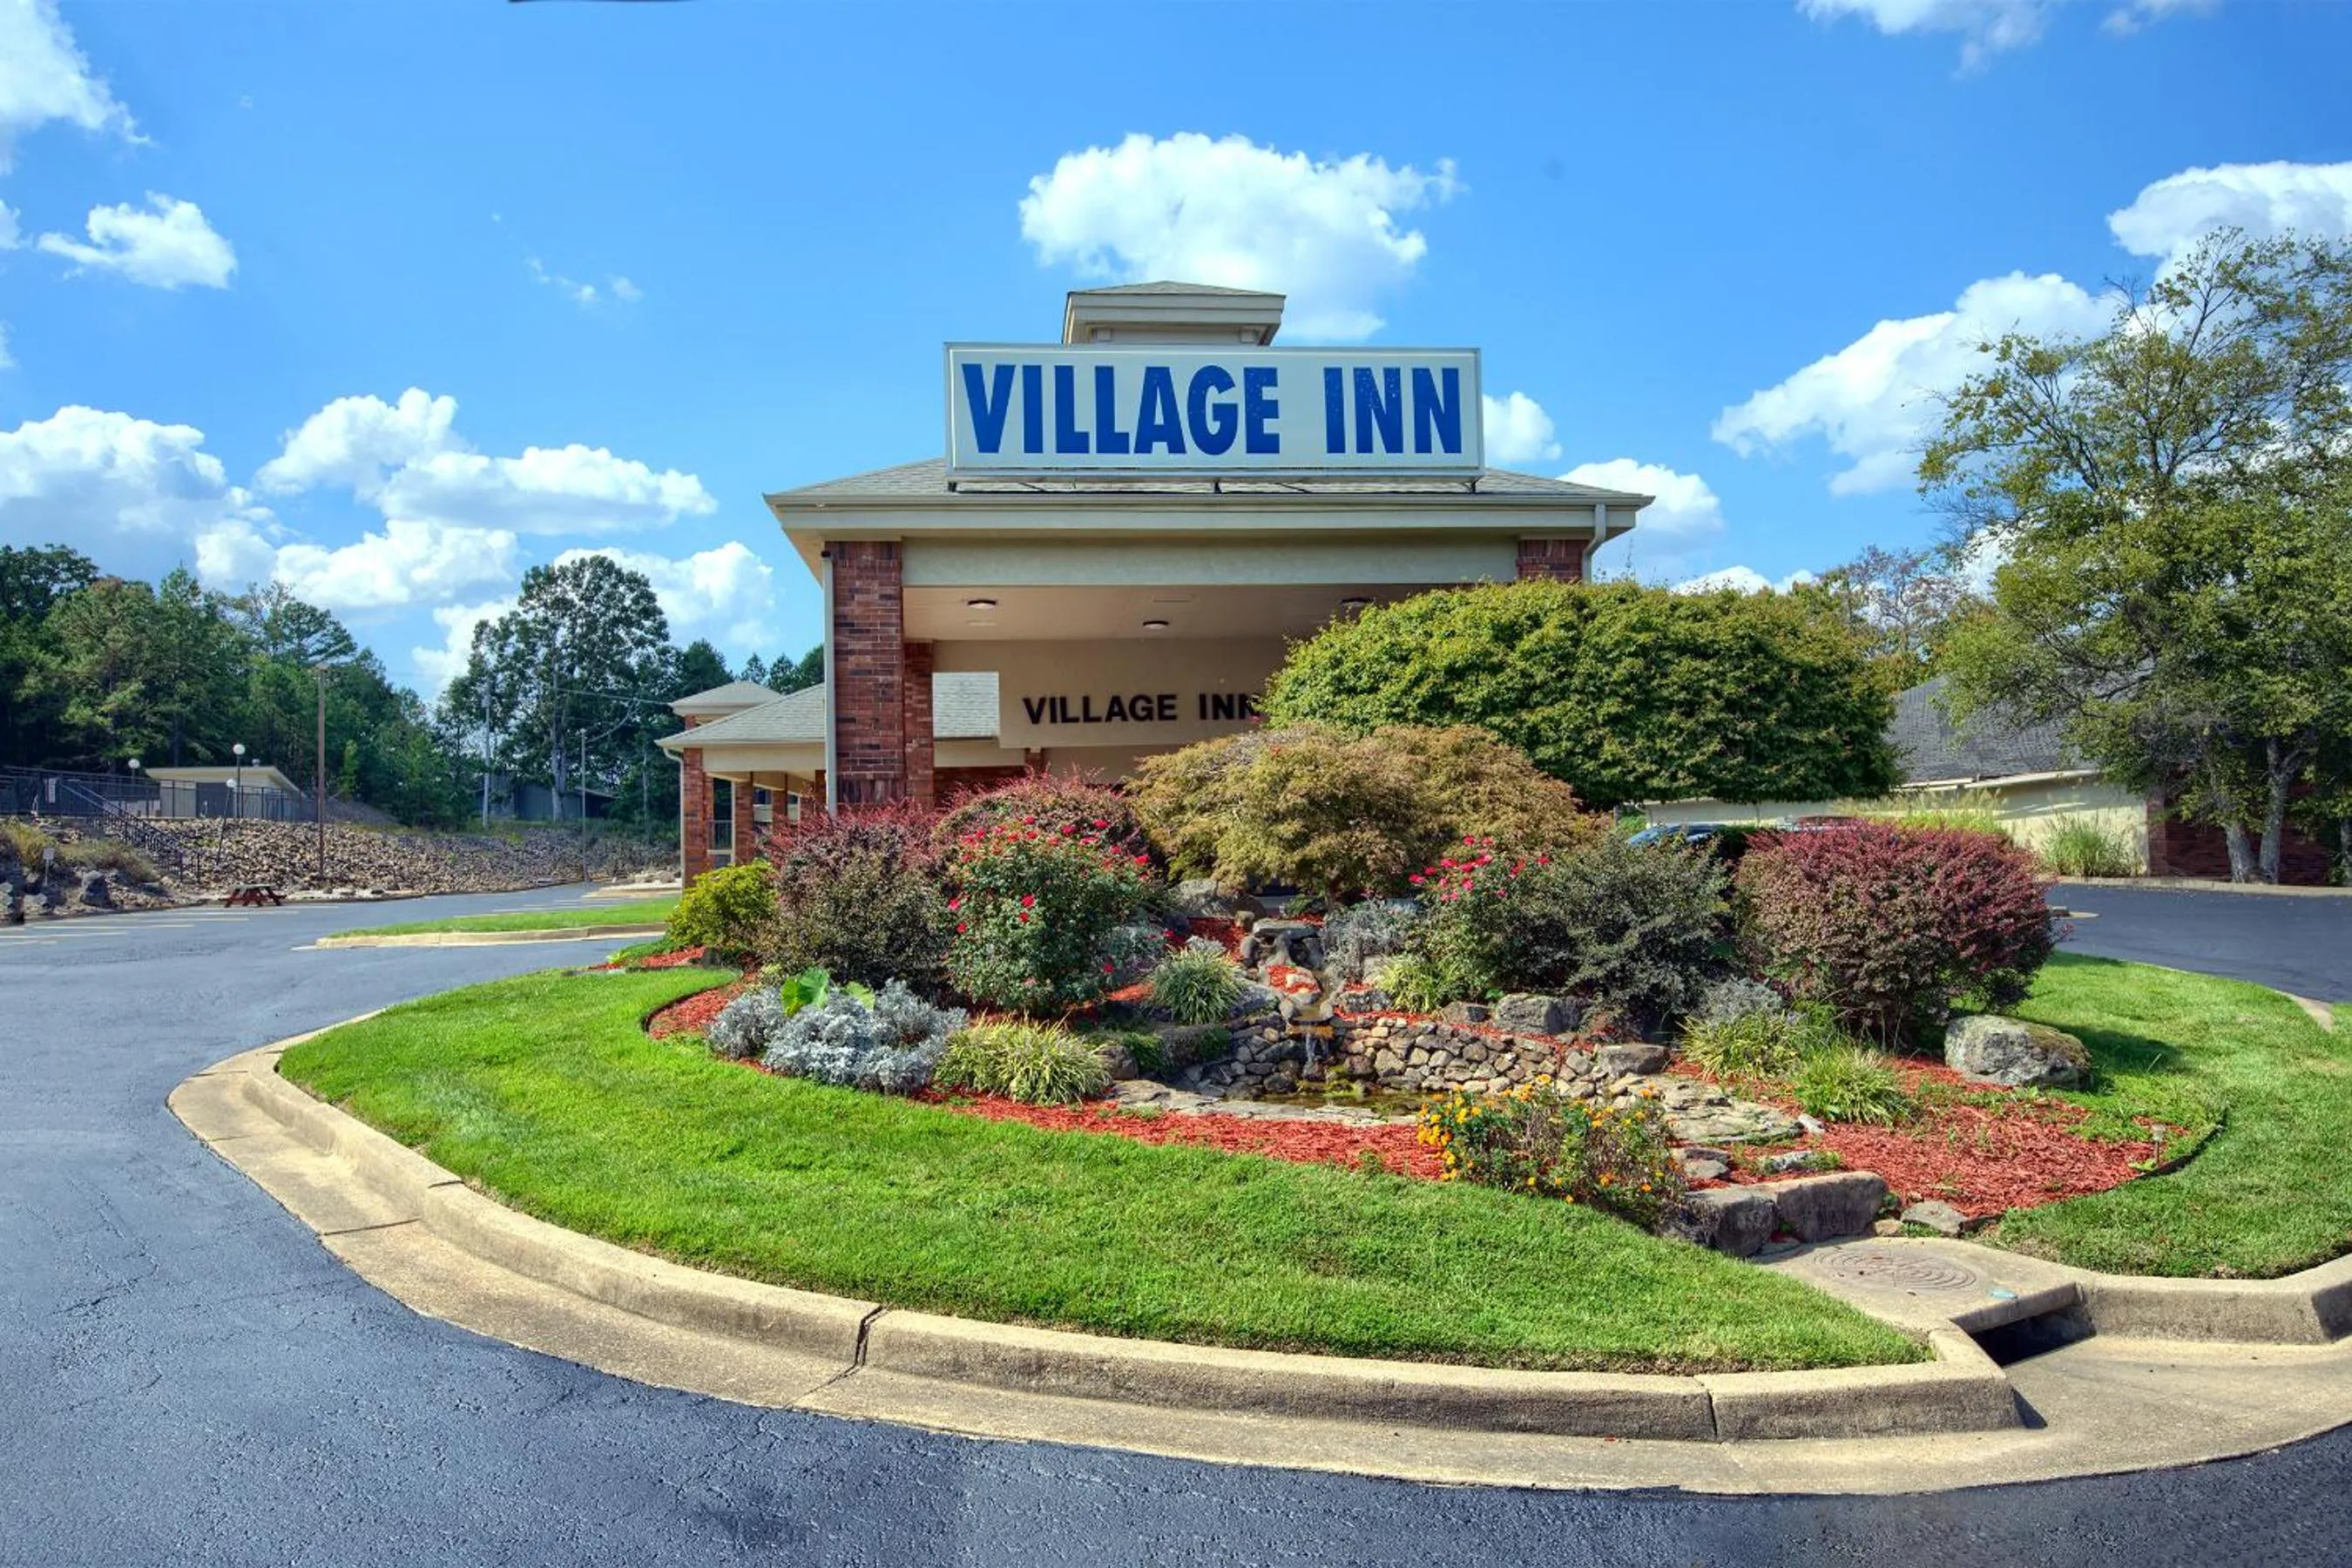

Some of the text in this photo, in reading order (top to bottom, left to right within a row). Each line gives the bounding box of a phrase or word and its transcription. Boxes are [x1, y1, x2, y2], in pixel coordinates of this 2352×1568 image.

[962, 363, 1463, 455] VILLAGE INN
[1023, 694, 1178, 725] VILLAGE
